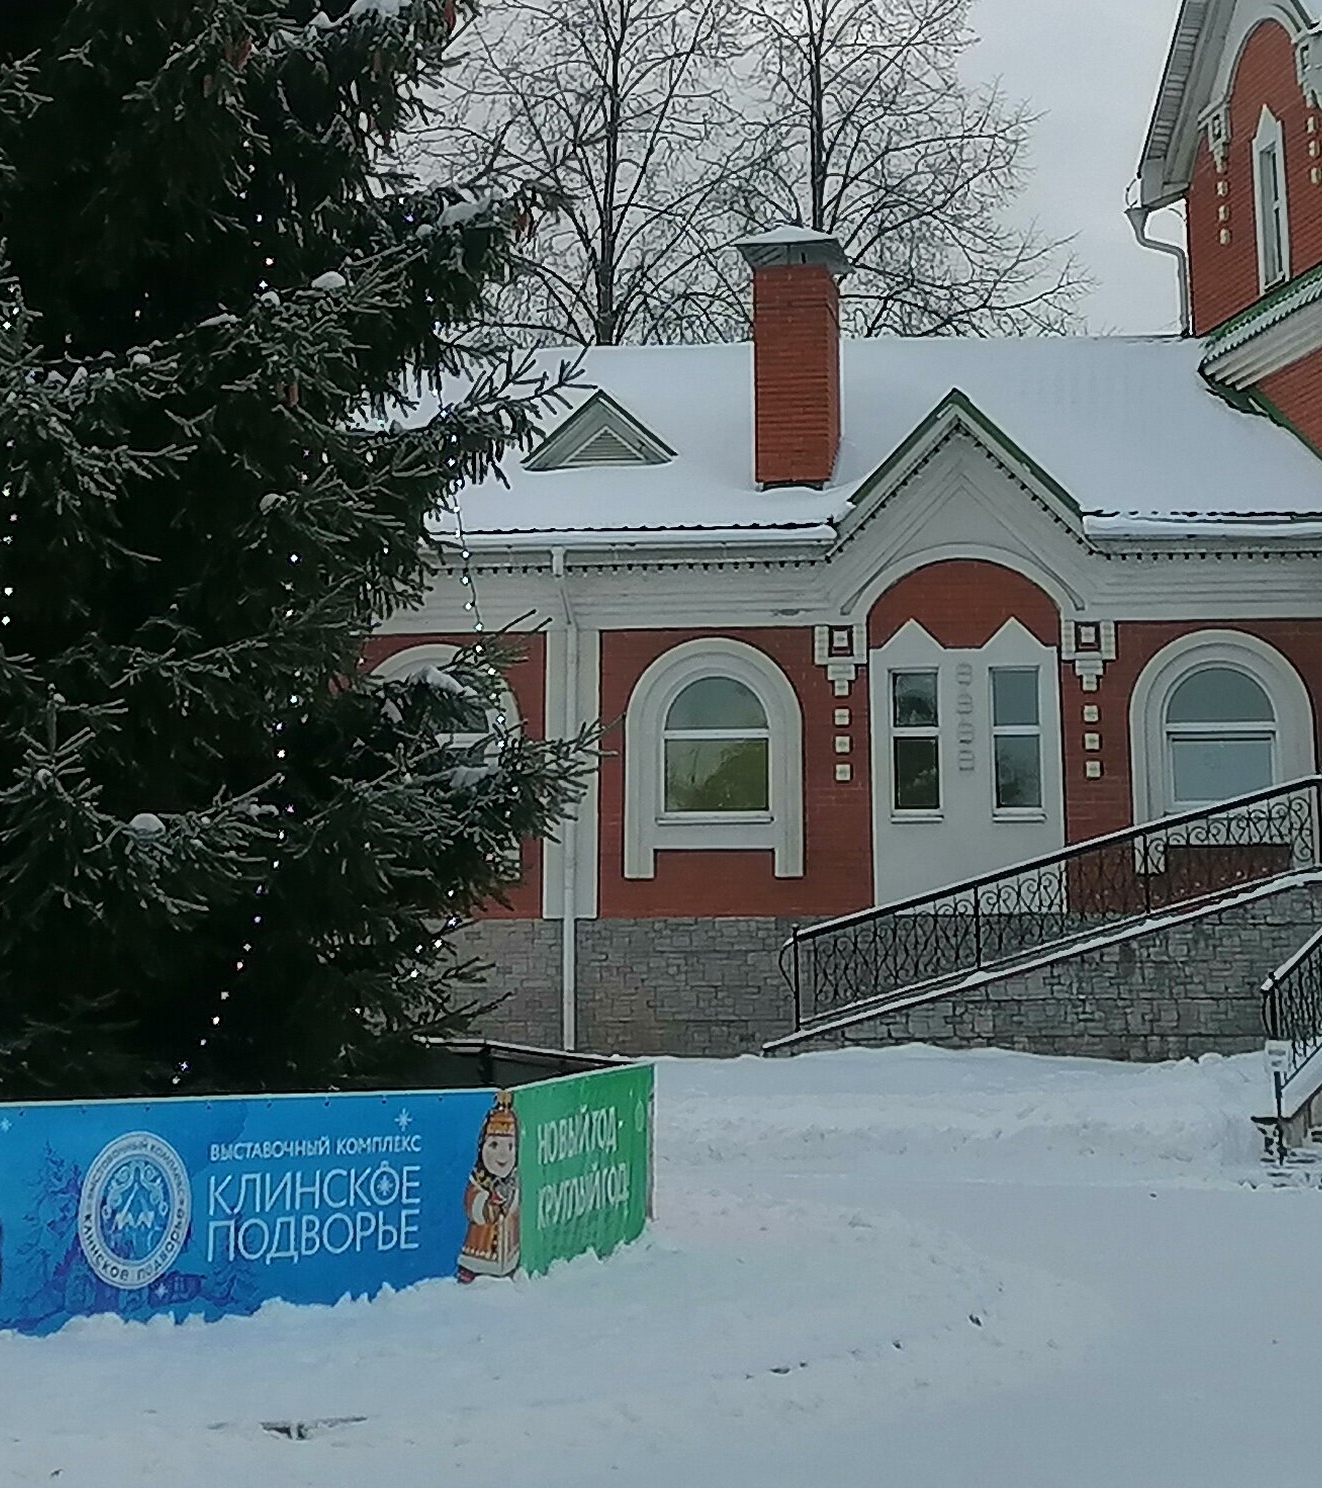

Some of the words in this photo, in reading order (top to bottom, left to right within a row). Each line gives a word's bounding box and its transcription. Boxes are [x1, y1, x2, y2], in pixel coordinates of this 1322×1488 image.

[209, 1136, 330, 1161] ВЫСТАВОЧНЫЙ
[335, 1134, 422, 1155] КОМПЛЕКС
[538, 1104, 590, 1165] НОВЫЙ
[591, 1106, 617, 1154] ГОД
[208, 1162, 421, 1216] КЛИНСКОЕ
[208, 1209, 420, 1265] ПОДВОРЬЕ
